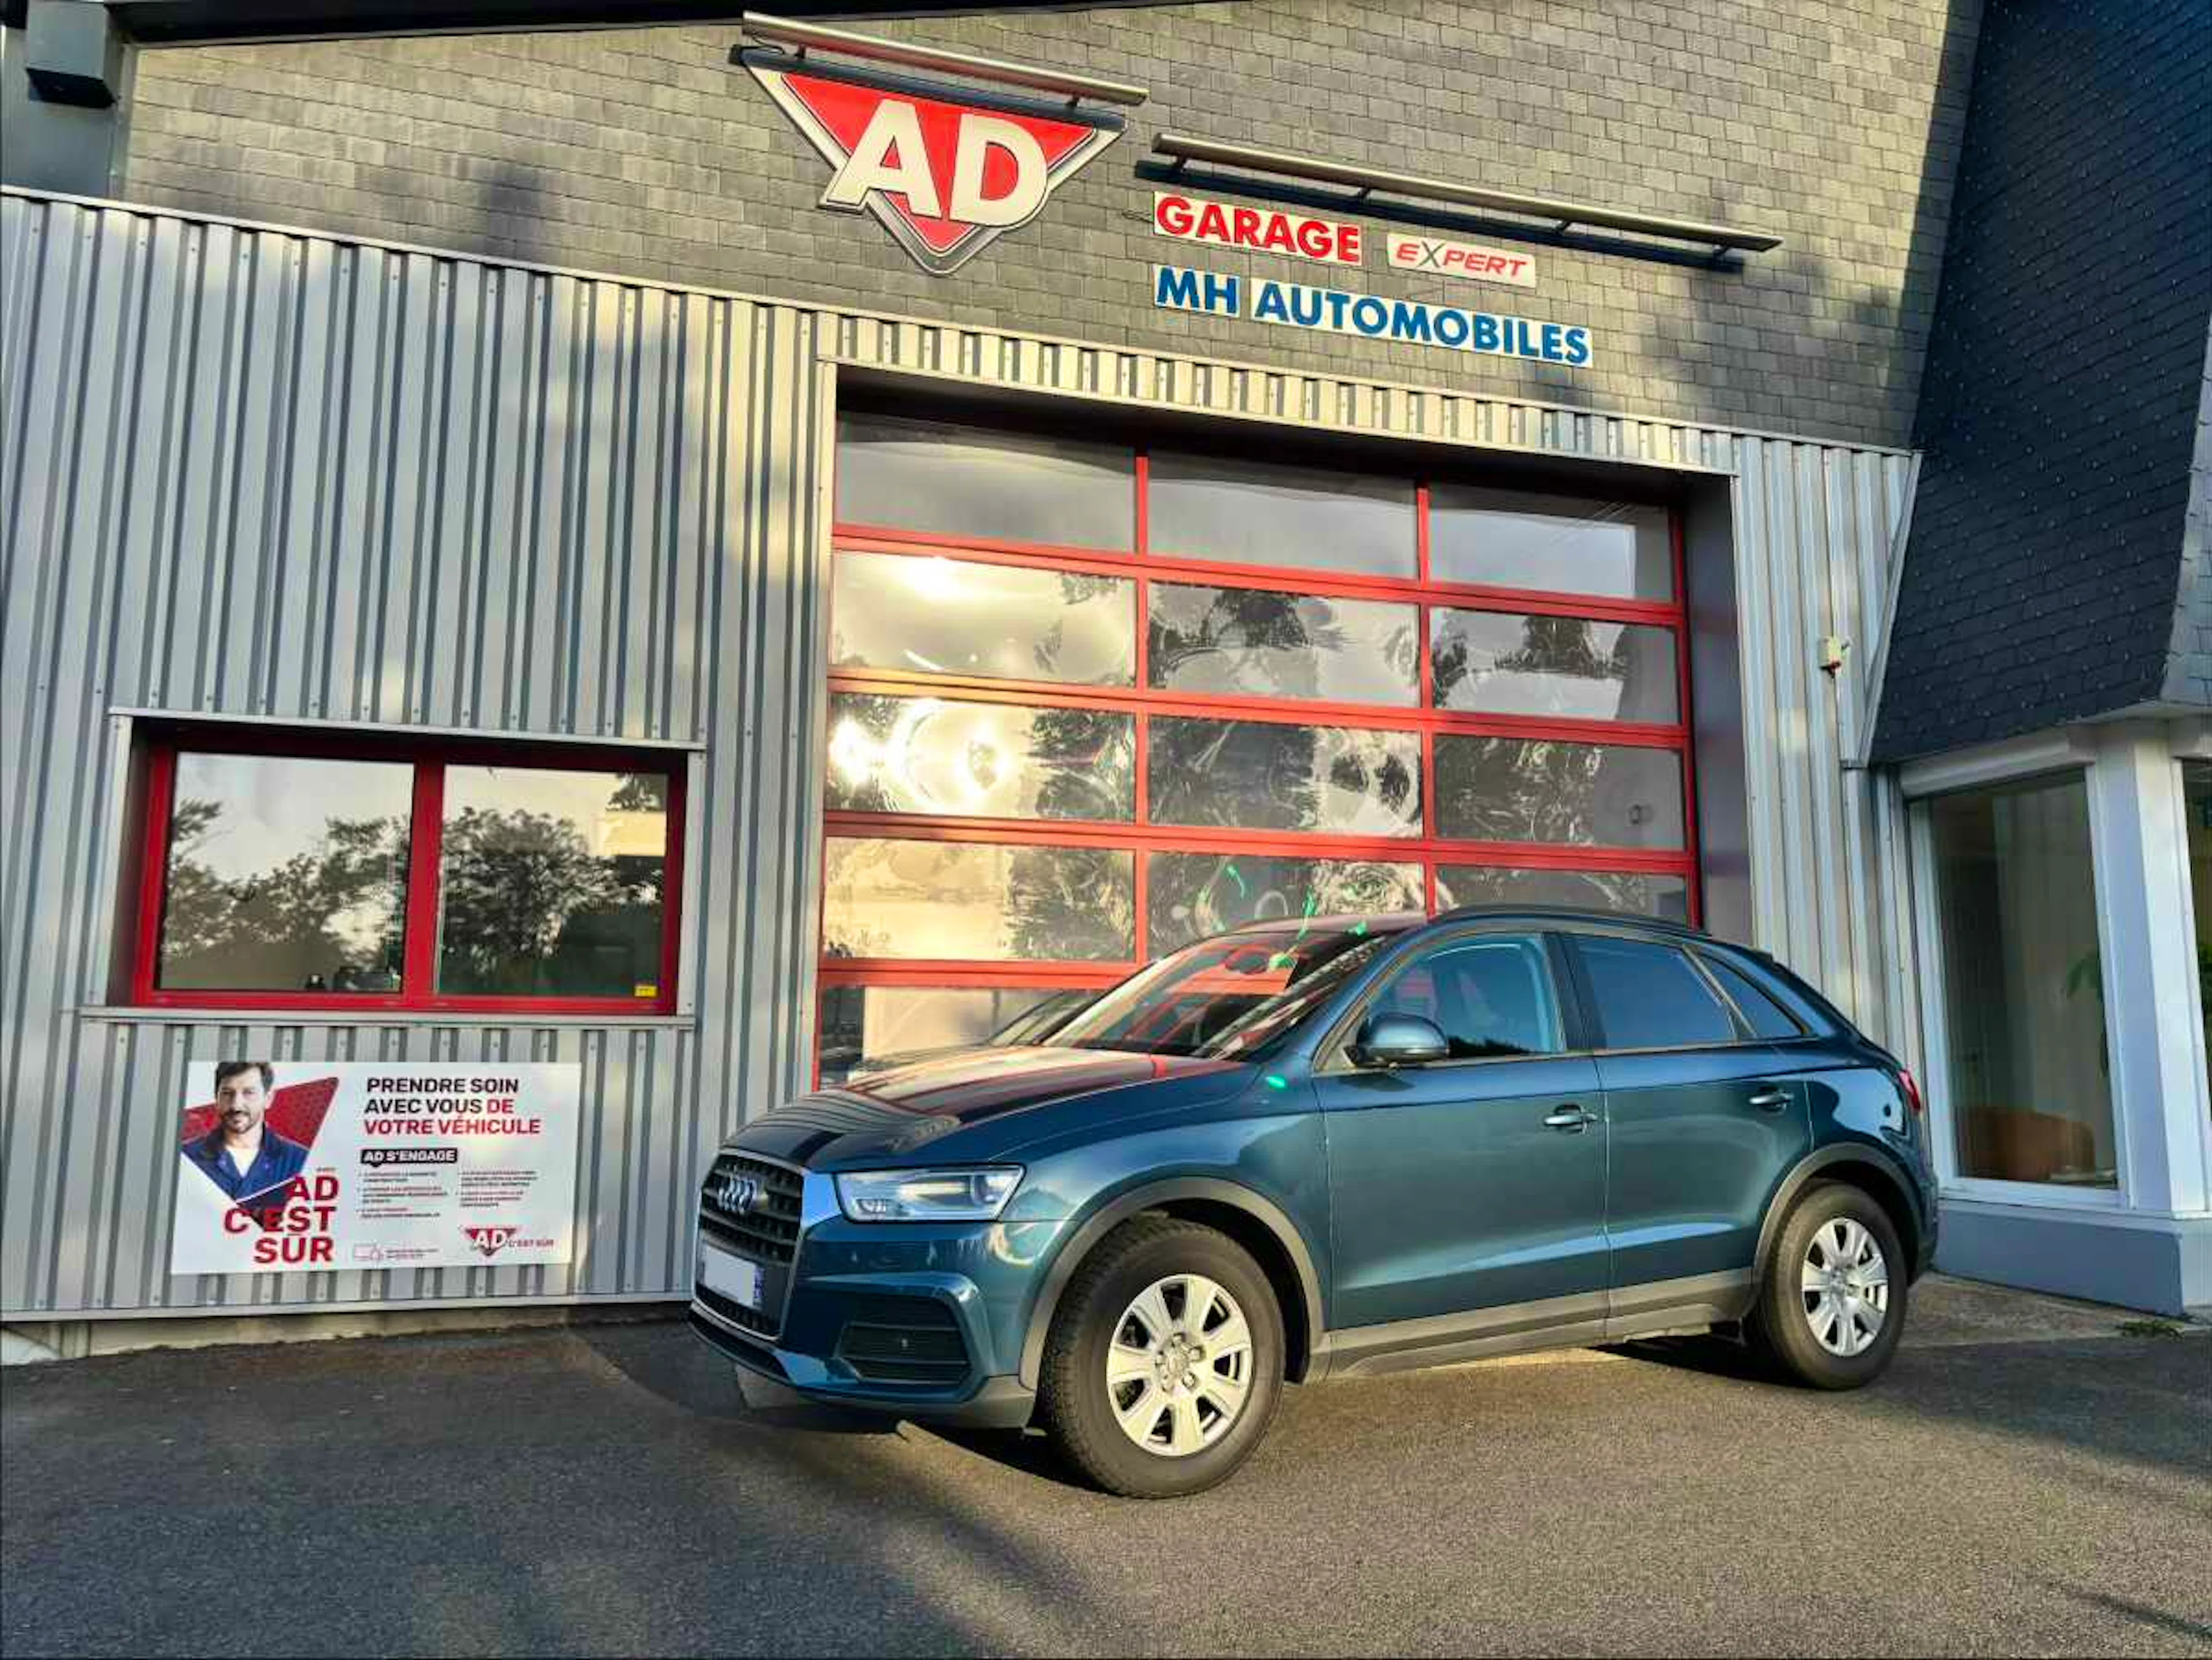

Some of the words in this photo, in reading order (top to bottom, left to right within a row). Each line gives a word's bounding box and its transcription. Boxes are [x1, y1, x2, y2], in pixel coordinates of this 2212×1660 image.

[823, 98, 1048, 227] AD
[1156, 195, 1360, 262] GARAGE
[1156, 266, 1238, 315] MH
[1254, 281, 1590, 364] AUTOMOBILES
[366, 1078, 466, 1093] PRENDRE
[470, 1078, 519, 1093] SOIN
[364, 1098, 421, 1114] AVEC
[426, 1098, 482, 1114] VOUS
[487, 1098, 514, 1113] DE
[364, 1119, 433, 1135] VOTRE
[438, 1115, 541, 1134] VÉHICULE
[288, 1176, 339, 1200] AD
